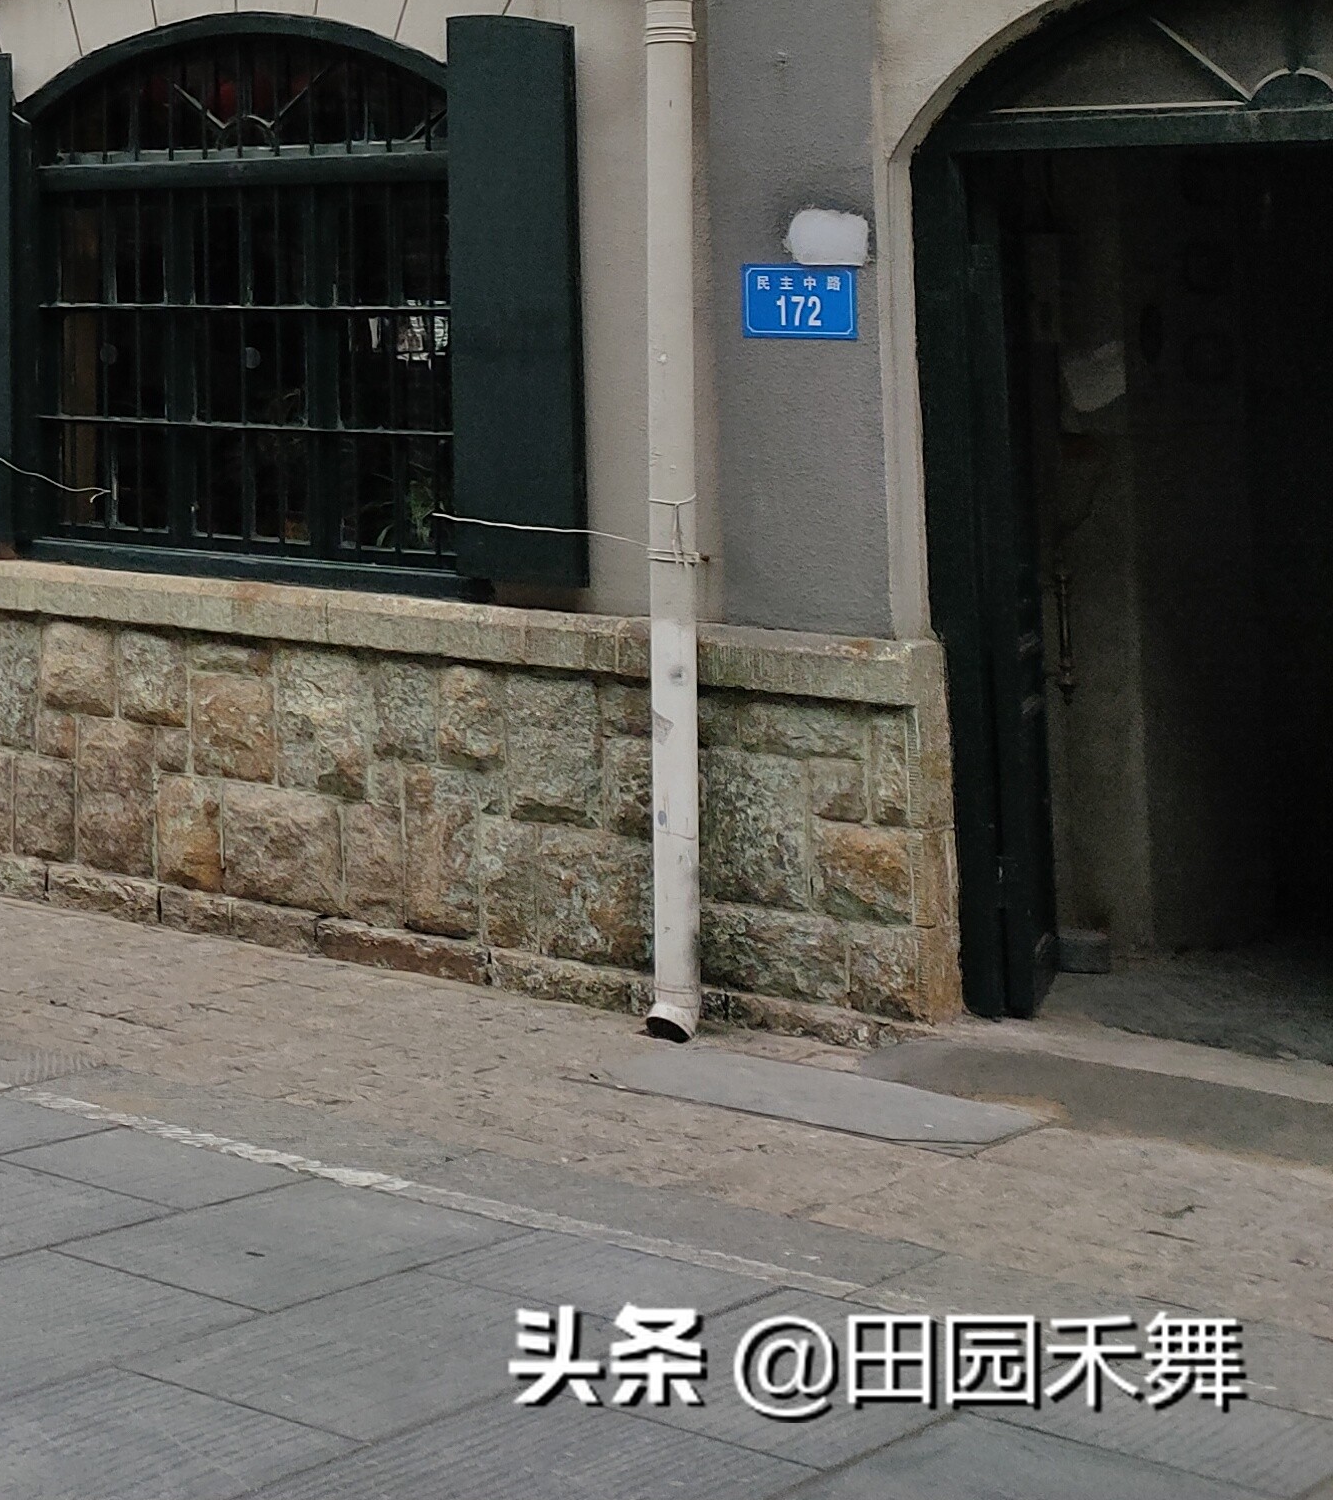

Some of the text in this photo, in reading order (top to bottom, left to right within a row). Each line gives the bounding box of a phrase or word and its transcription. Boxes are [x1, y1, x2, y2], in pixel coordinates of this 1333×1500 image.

[756, 275, 842, 292] 民主中路
[775, 294, 823, 327] 172
